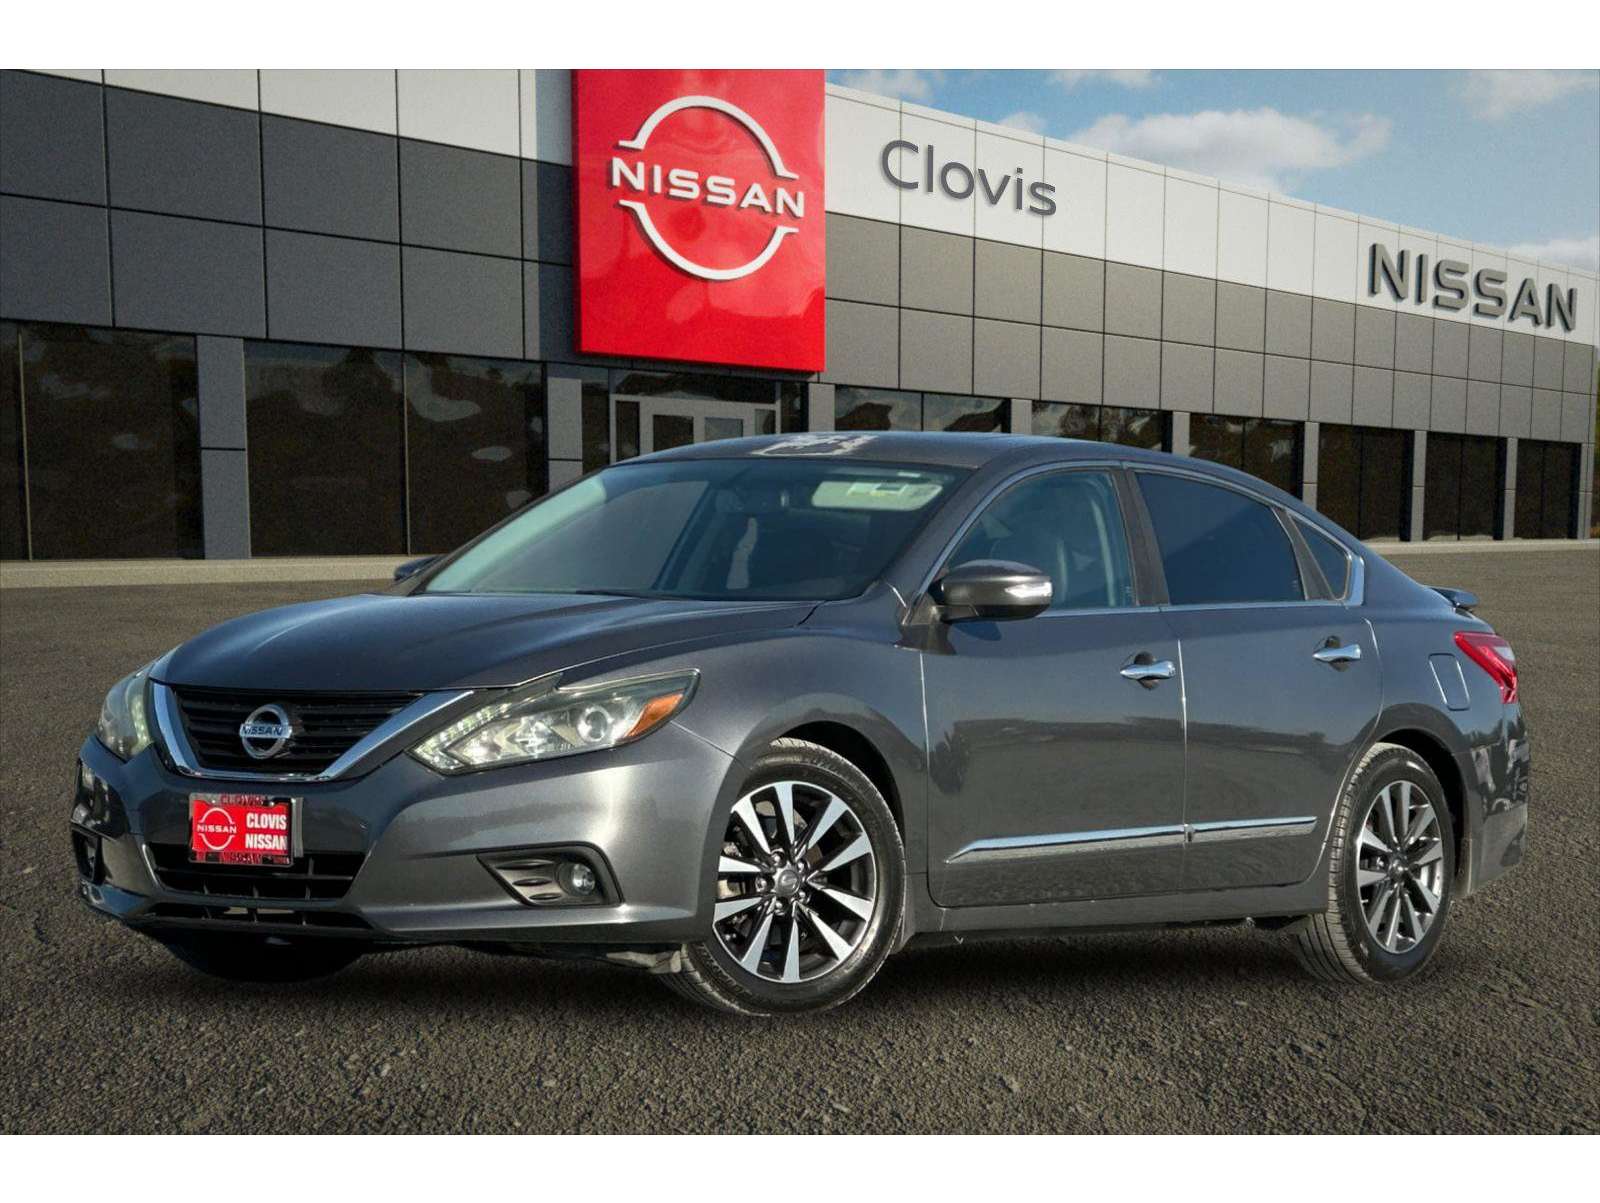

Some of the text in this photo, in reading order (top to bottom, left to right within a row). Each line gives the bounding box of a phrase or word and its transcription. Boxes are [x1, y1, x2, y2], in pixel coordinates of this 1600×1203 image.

[881, 139, 1057, 216] Clovis
[611, 156, 805, 218] NISSAN
[1368, 243, 1578, 332] NISSAN
[242, 725, 284, 736] NISSAN
[196, 824, 237, 834] NISSAN
[246, 812, 287, 830] CLOVIS
[245, 833, 288, 851] NISSAN
